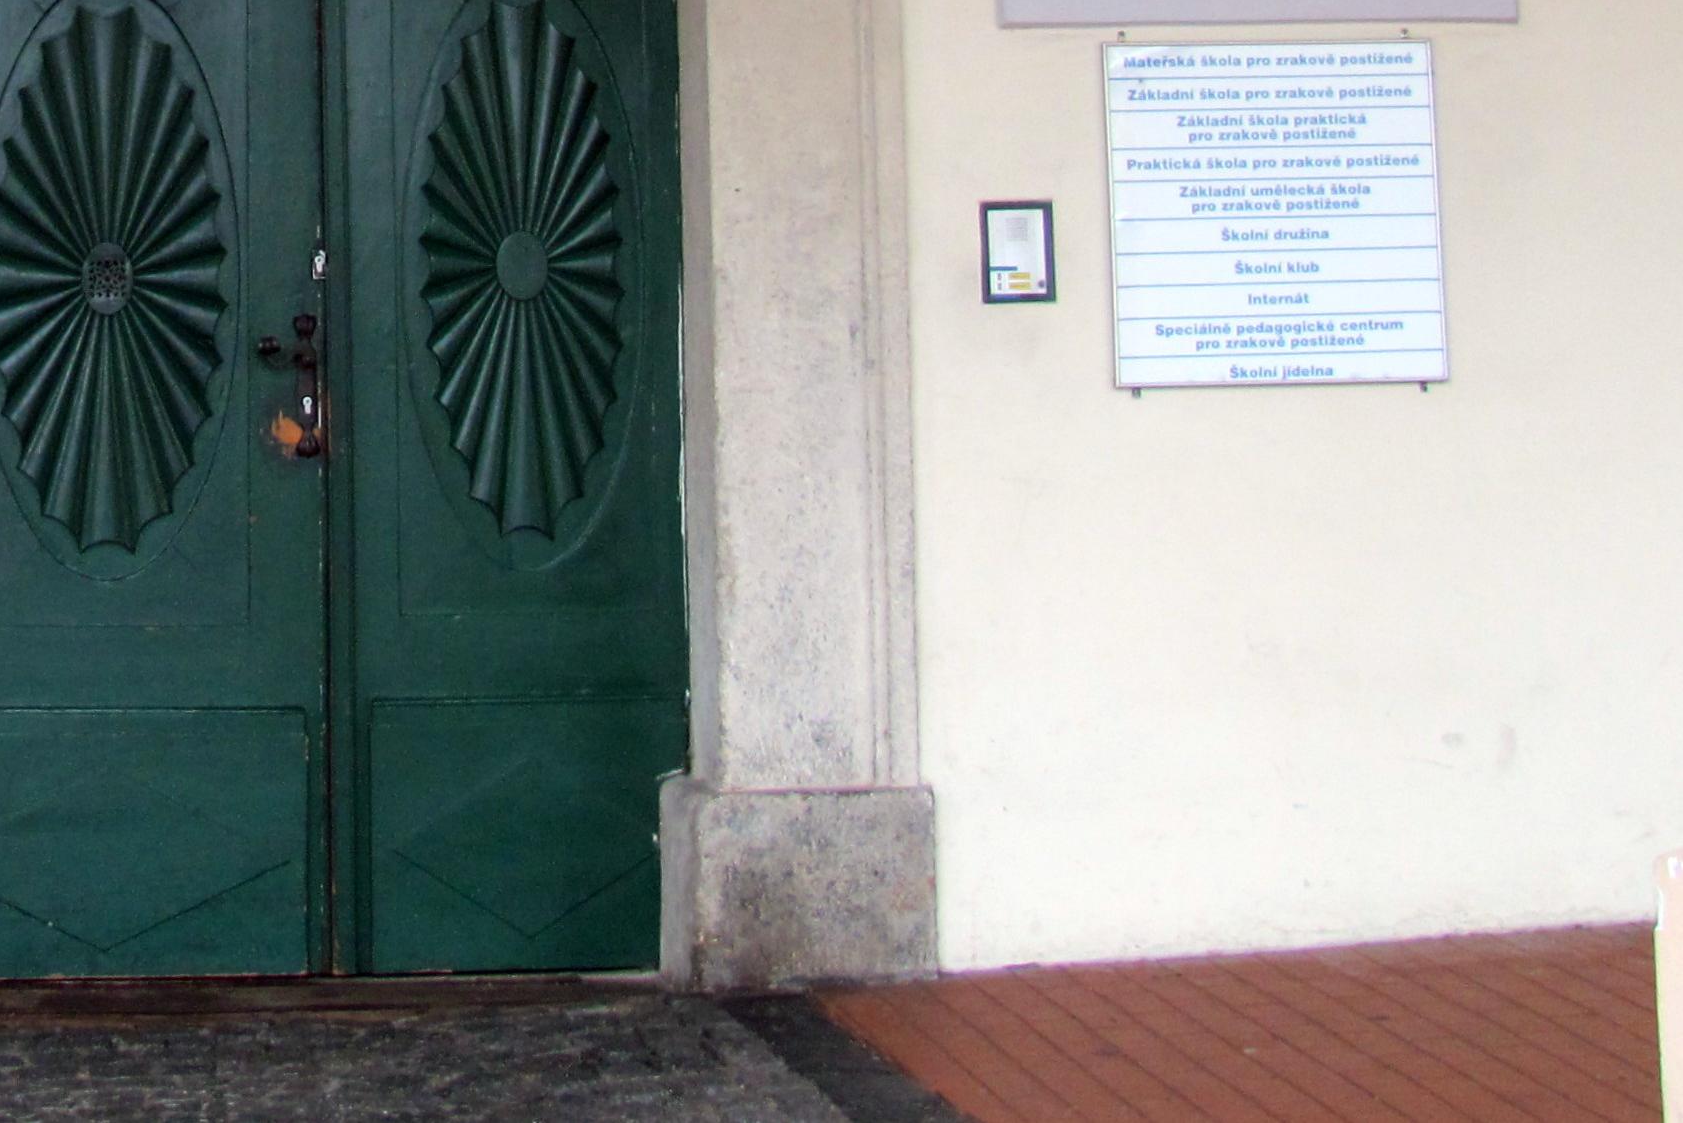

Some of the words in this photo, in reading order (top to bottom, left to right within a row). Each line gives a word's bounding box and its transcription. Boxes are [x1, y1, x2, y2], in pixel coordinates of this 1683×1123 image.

[1123, 55, 1195, 69] Mateřská
[1200, 55, 1242, 68] škola
[1246, 56, 1271, 69] pro
[1275, 53, 1335, 66] zrakově
[1339, 52, 1414, 67] postižené
[1127, 88, 1195, 101] Základní
[1199, 88, 1241, 100] škola
[1244, 89, 1270, 101] pro
[1274, 86, 1334, 99] zrakově
[1338, 85, 1413, 99] postižené
[1176, 114, 1244, 127] Základní
[1247, 114, 1289, 126] škola
[1293, 113, 1368, 127] praktická
[1188, 132, 1214, 144] pro
[1218, 128, 1279, 141] zrakově
[1283, 127, 1358, 142] postižené
[1126, 157, 1202, 170] Praktická
[1206, 156, 1248, 169] škola
[1252, 158, 1277, 170] pro
[1282, 155, 1342, 168] zrakově
[1346, 153, 1421, 169] postižené
[1179, 184, 1246, 198] Základní
[1250, 182, 1326, 197] umělecká
[1330, 181, 1372, 196] škola
[1191, 202, 1217, 215] pro
[1221, 199, 1282, 211] zrakově
[1286, 197, 1361, 212] postižené
[1221, 226, 1269, 242] Školní
[1273, 228, 1330, 241] družina
[1234, 259, 1283, 275] Školní
[1286, 261, 1321, 274] klub
[1247, 292, 1311, 305] Internát
[1236, 320, 1335, 337] pedagogické
[1339, 319, 1405, 332] centrum
[1195, 339, 1221, 352] pro
[1225, 336, 1286, 349] zrakově
[1290, 334, 1365, 349] postižené
[1229, 363, 1278, 379] Školní
[1281, 365, 1334, 380] jídelna
